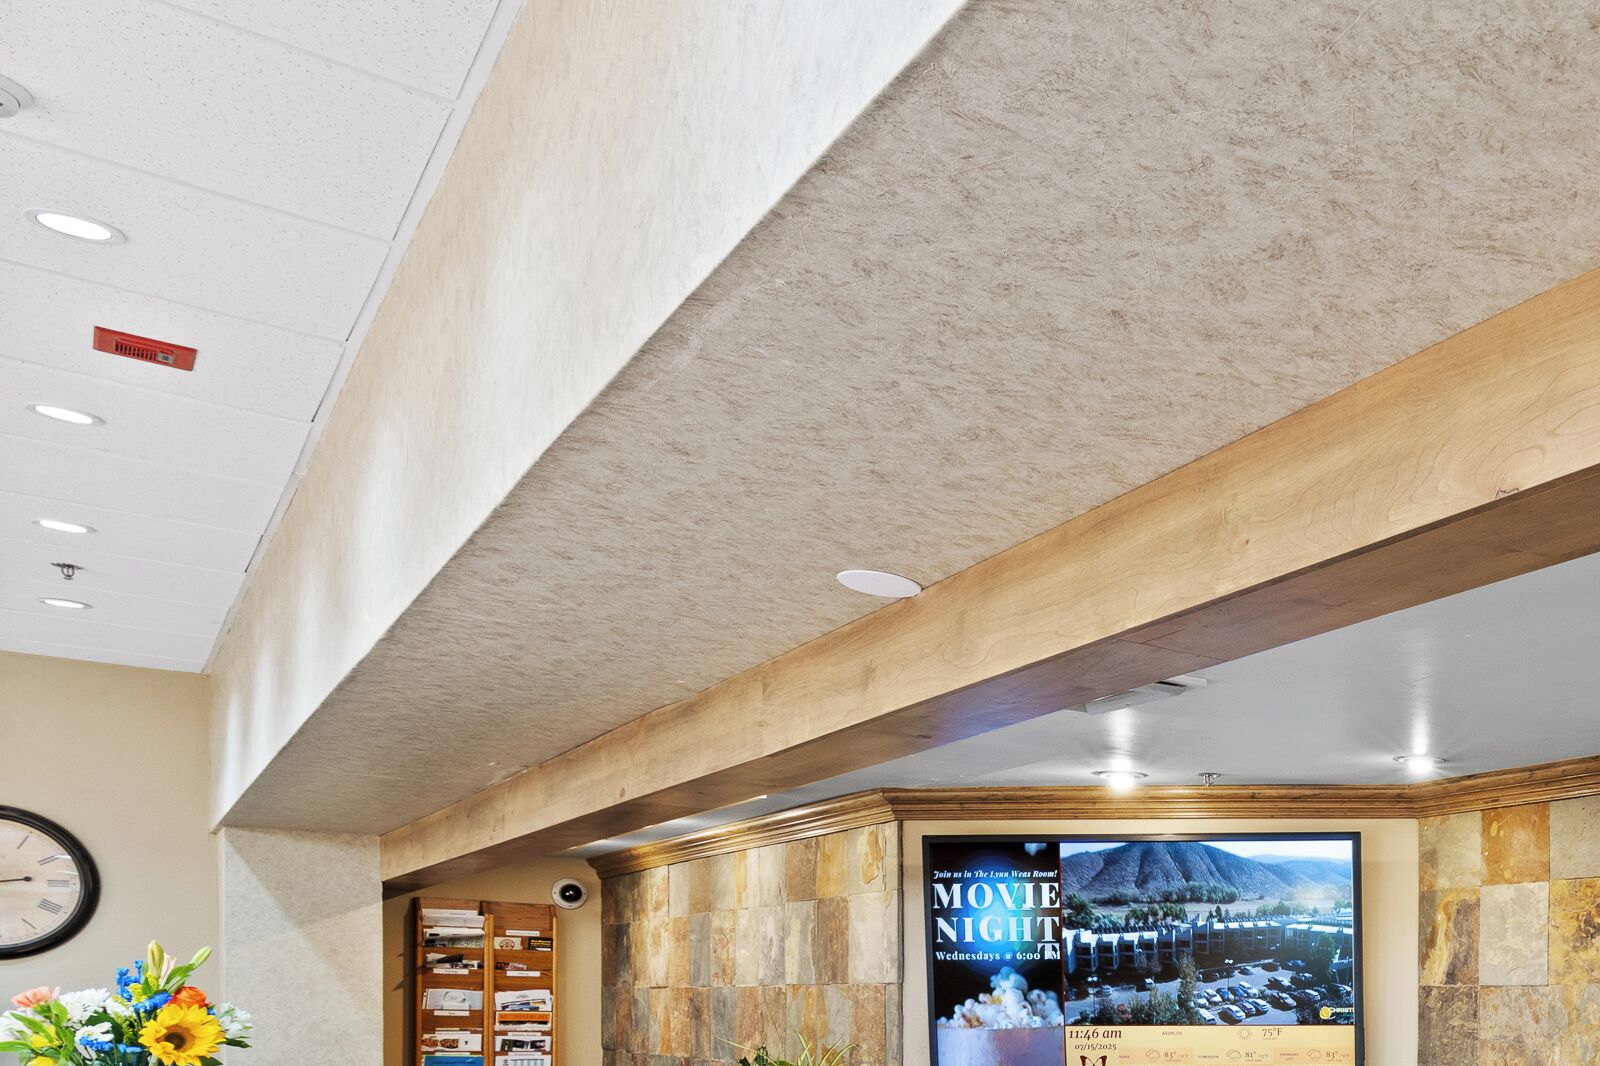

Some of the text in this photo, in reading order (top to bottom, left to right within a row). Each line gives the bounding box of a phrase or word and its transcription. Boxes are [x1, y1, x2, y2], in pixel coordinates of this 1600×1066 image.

[933, 870, 951, 879] Join
[964, 870, 972, 878] in
[974, 869, 988, 878] The
[990, 870, 1009, 879] Lynn
[1032, 869, 1058, 878] Room!
[932, 882, 1060, 909] MOVIE
[935, 915, 1060, 942] NIGHT
[935, 951, 1001, 961] Wednesdays
[1005, 952, 1012, 960] @
[1016, 951, 1041, 960] 6:00
[1068, 1027, 1122, 1040] 11:46 am
[1261, 1027, 1283, 1037] 75°F
[1074, 1042, 1117, 1051] 07/15/2025
